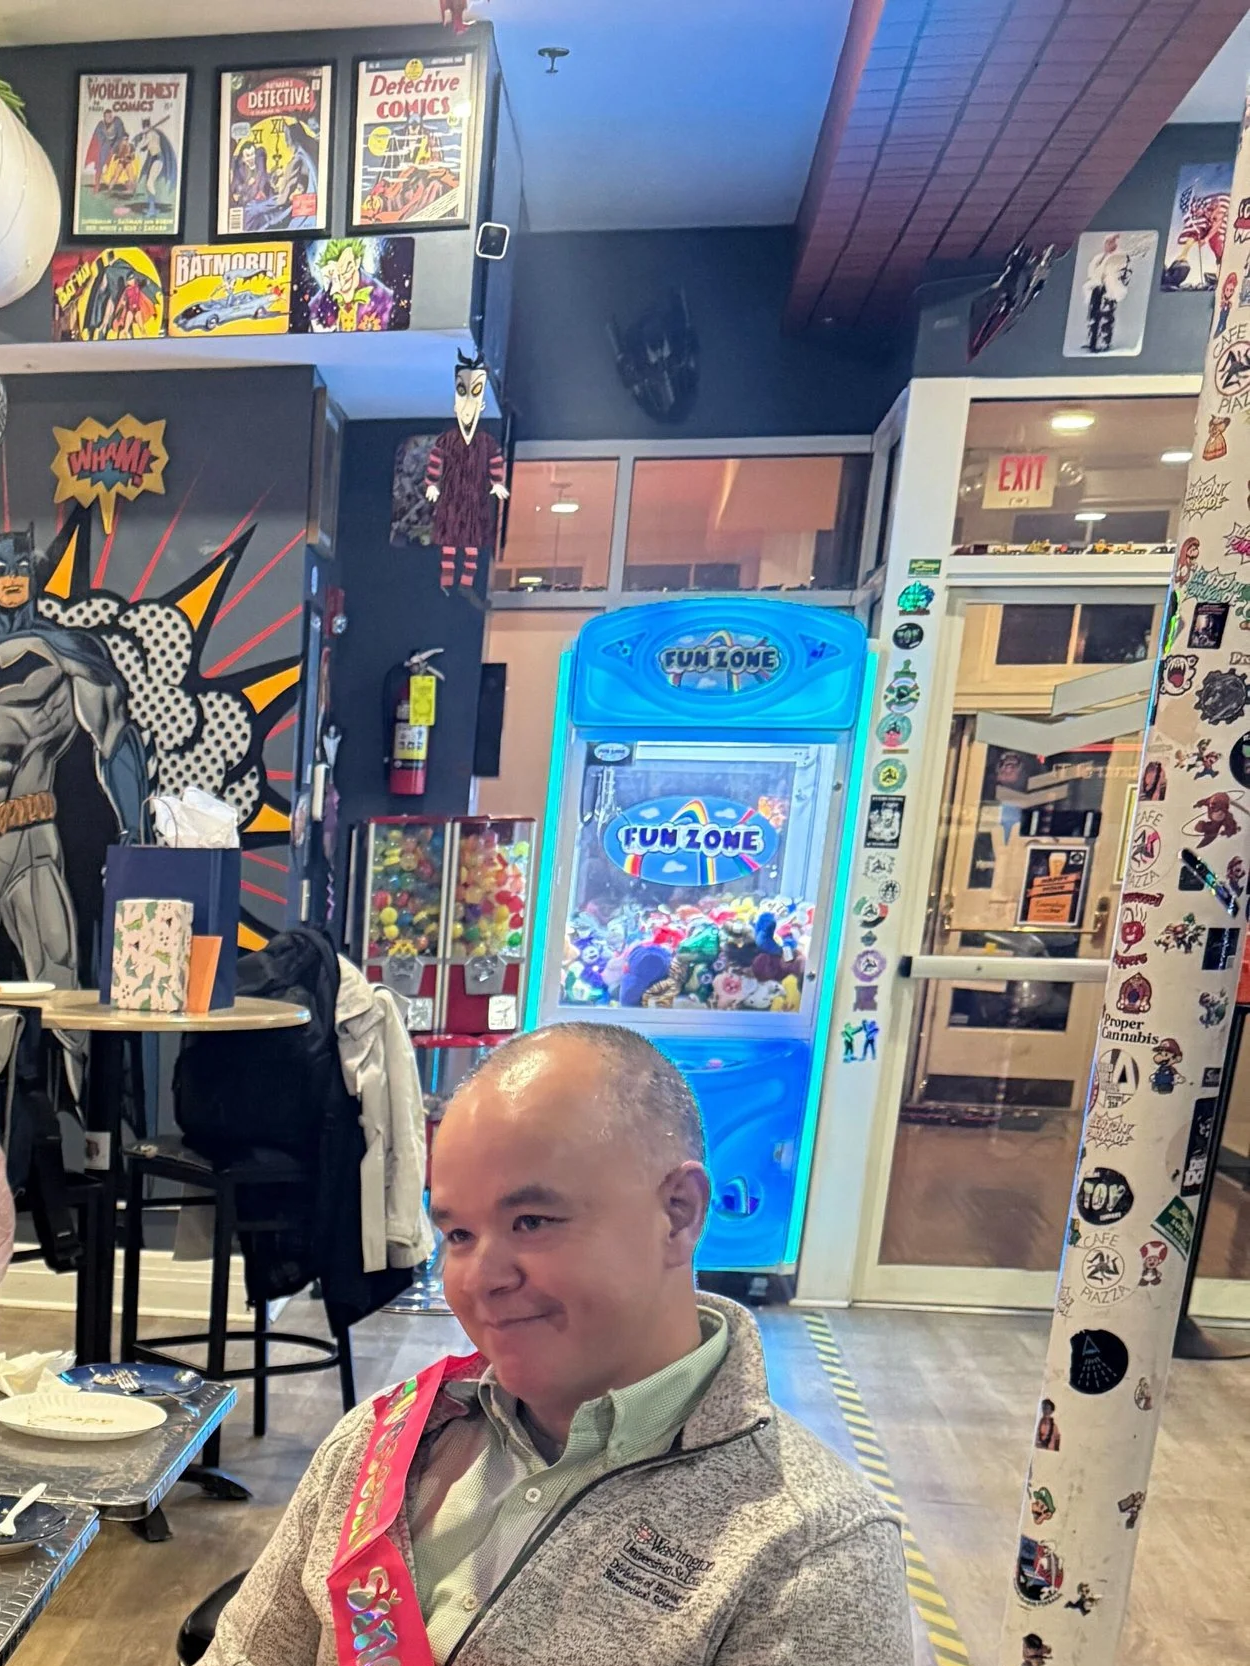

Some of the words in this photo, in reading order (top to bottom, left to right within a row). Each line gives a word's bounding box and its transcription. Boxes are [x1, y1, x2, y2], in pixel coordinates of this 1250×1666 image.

[88, 81, 136, 100] WORLD'S
[370, 71, 460, 96] Detective
[112, 100, 154, 112] COMICS
[248, 86, 311, 109] DETECTIVE
[377, 97, 450, 119] COMICS
[68, 437, 151, 487] WHAM!
[998, 455, 1047, 492] EXIT
[664, 650, 709, 668] FUN
[715, 650, 777, 669] ZONE
[623, 827, 678, 849] FUN
[685, 828, 760, 852] ZONE
[1104, 1013, 1145, 1031] Proper
[1102, 1026, 1159, 1045] Cannabis
[1083, 1181, 1126, 1212] TOY
[1083, 1232, 1119, 1249] CAFE
[1080, 1285, 1132, 1304] PIAZZA
[651, 1534, 715, 1572] Washington
[603, 1567, 649, 1601] Biomedical
[610, 1558, 643, 1584] Division
[643, 1578, 655, 1589] of
